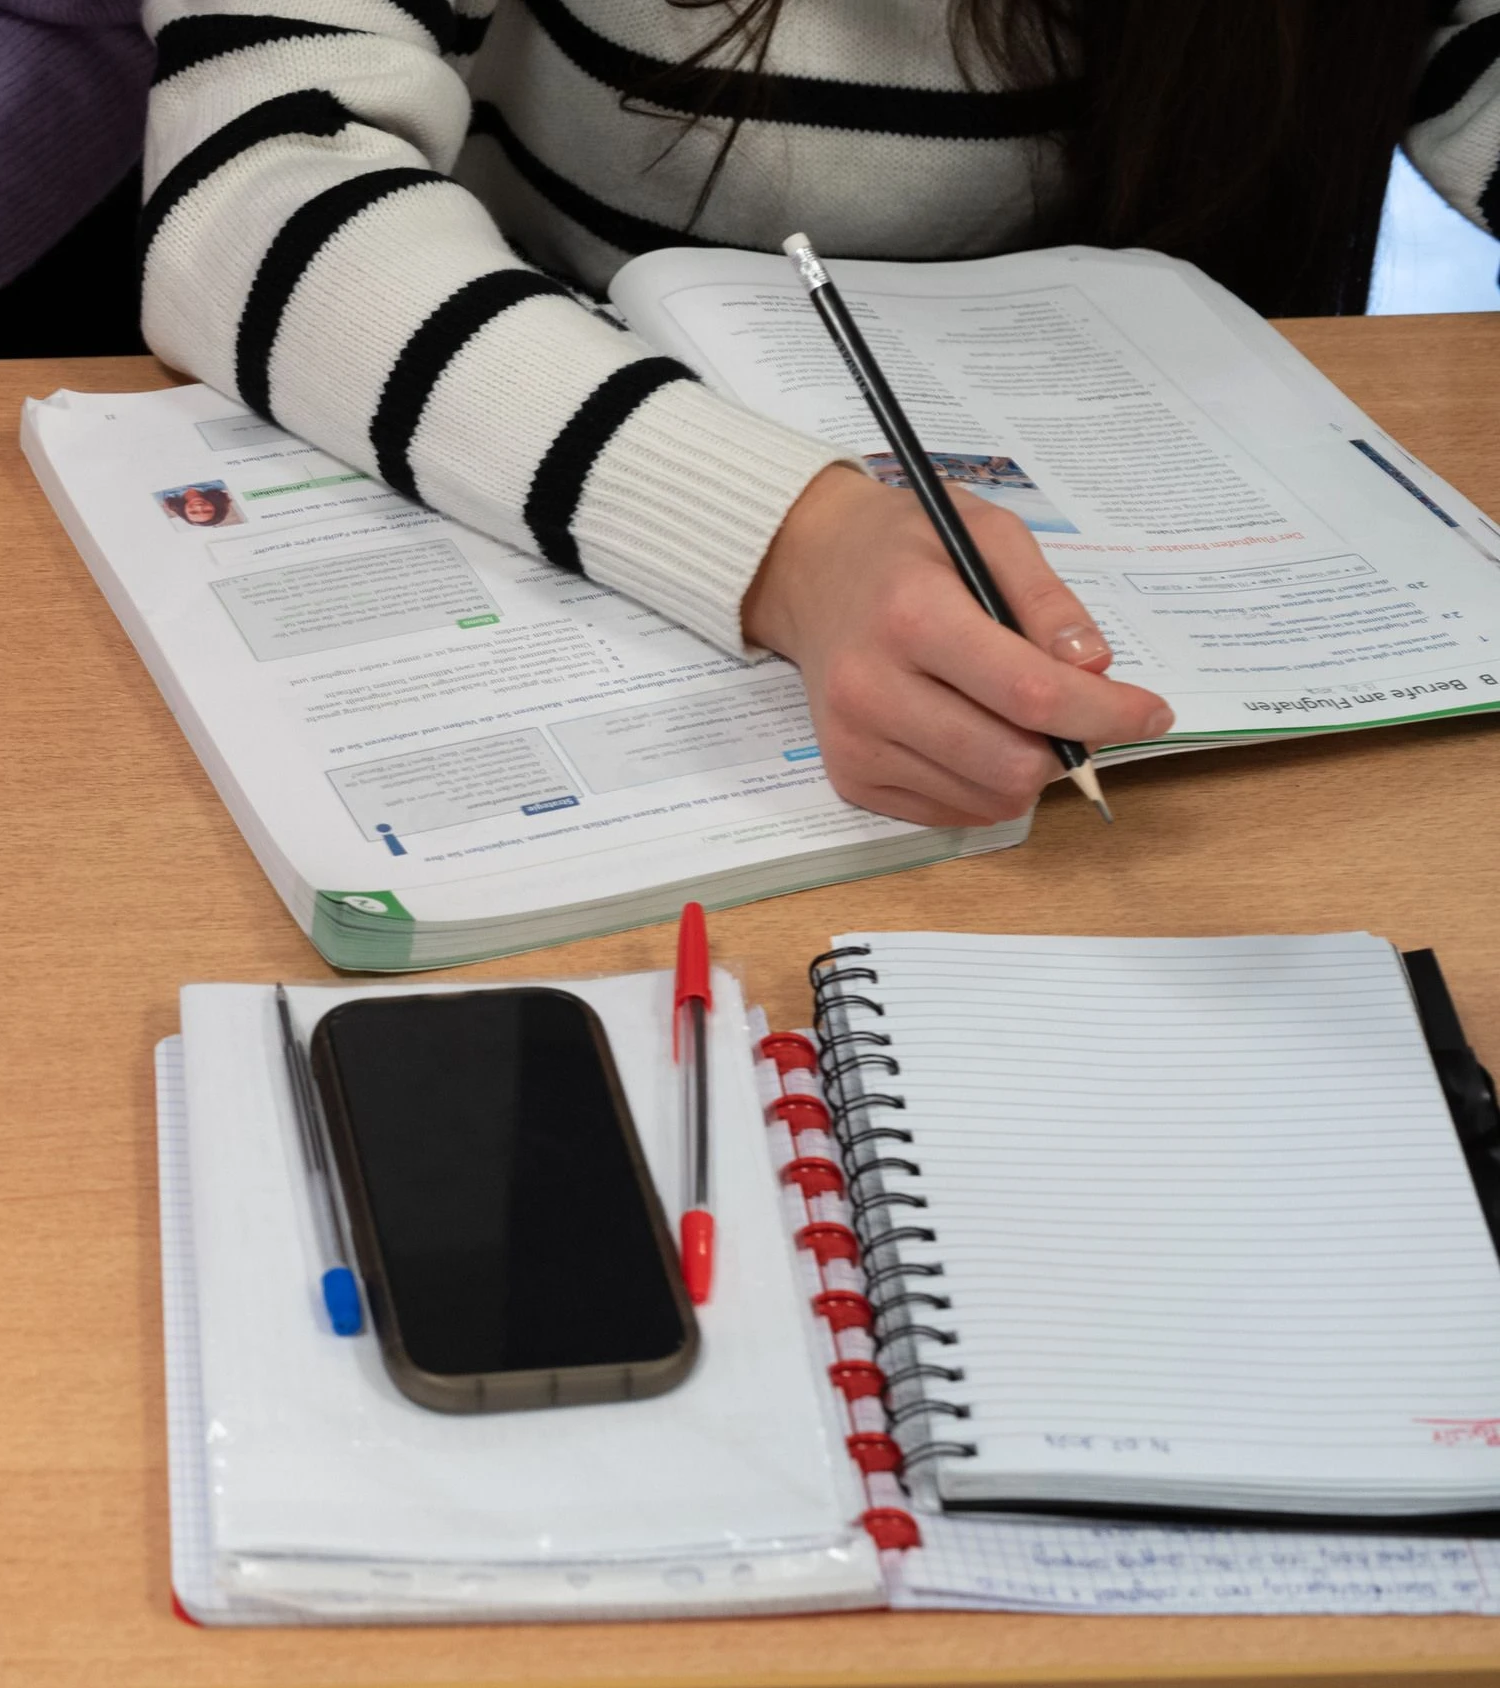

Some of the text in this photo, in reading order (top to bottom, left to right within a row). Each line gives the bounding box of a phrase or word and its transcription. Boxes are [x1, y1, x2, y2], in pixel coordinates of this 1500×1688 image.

[251, 483, 310, 498] Zufriedenheit
[462, 615, 494, 627] Memo
[1479, 673, 1498, 686] B
[1390, 678, 1468, 701] Berufe
[1242, 697, 1353, 715] Flughafen
[1352, 691, 1386, 706] am
[527, 797, 575, 813] Strategie
